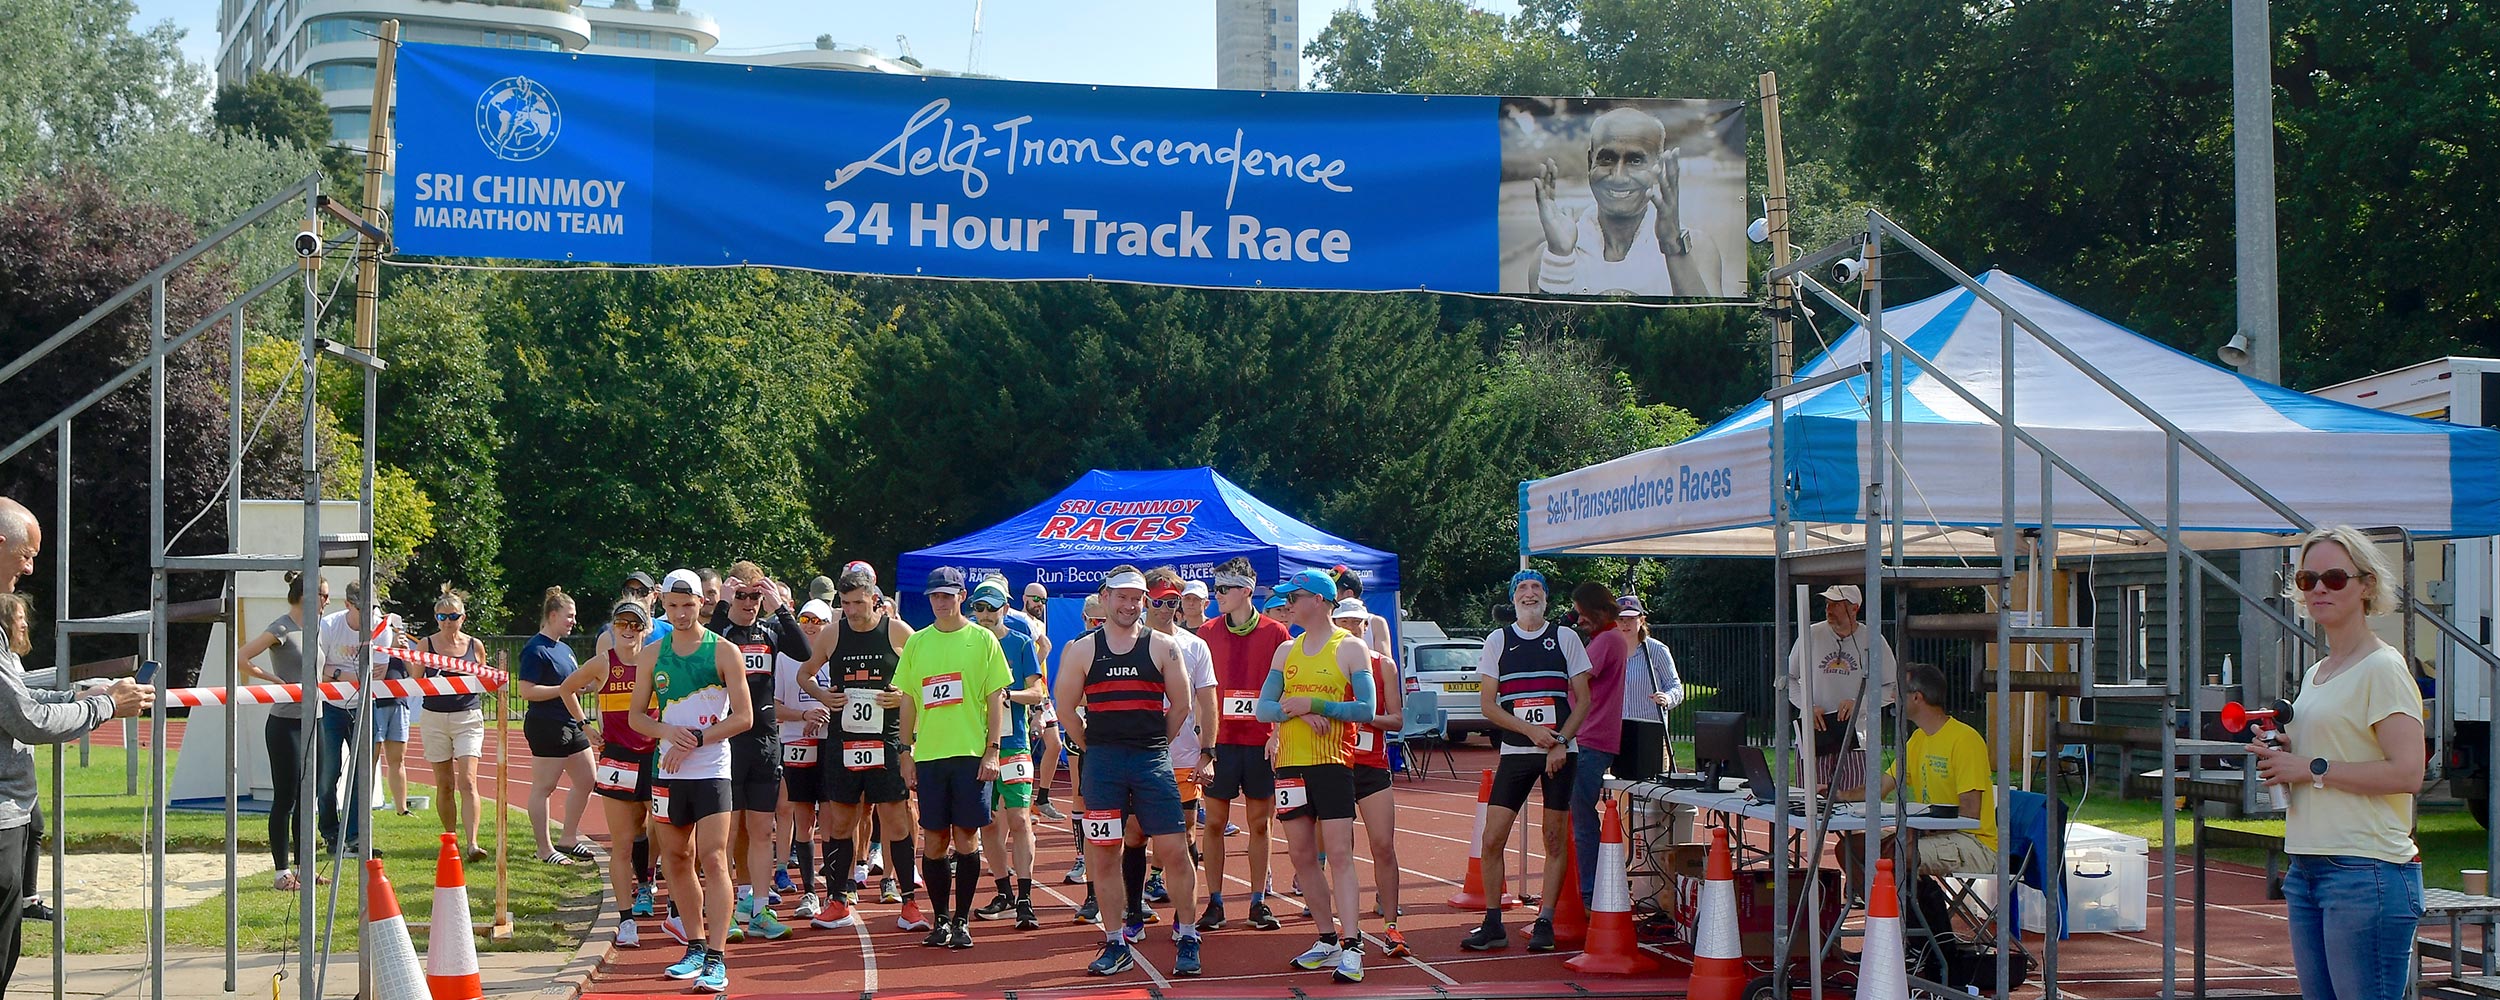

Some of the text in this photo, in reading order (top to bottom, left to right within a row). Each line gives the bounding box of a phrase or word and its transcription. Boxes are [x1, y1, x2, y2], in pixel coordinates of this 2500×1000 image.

[824, 97, 1353, 209] Self-Transcendence
[415, 173, 626, 208] SRI CHINMOY
[415, 207, 624, 236] MARATHON TEAM
[824, 200, 1351, 263] 24 Hour Track Race
[1547, 464, 1732, 526] Self-Transcendence Races
[1057, 499, 1203, 515] SRI CHINMOY
[1037, 516, 1194, 542] RACES
[1074, 543, 1125, 552] Chinmoy
[1036, 567, 1063, 583] Run
[1180, 568, 1216, 580] RACES
[746, 655, 764, 669] 50
[1818, 651, 1838, 669] SANTA
[1106, 667, 1139, 677] JURA
[933, 684, 950, 700] 42
[852, 703, 872, 721] 30
[1235, 700, 1253, 713] 24
[1525, 708, 1544, 722] 46
[791, 748, 807, 761] 37
[854, 751, 872, 764] 30
[610, 771, 619, 784] 4
[1017, 763, 1025, 776] 9
[652, 799, 659, 813] 5
[1280, 790, 1289, 806] 3
[1091, 822, 1110, 838] 34
